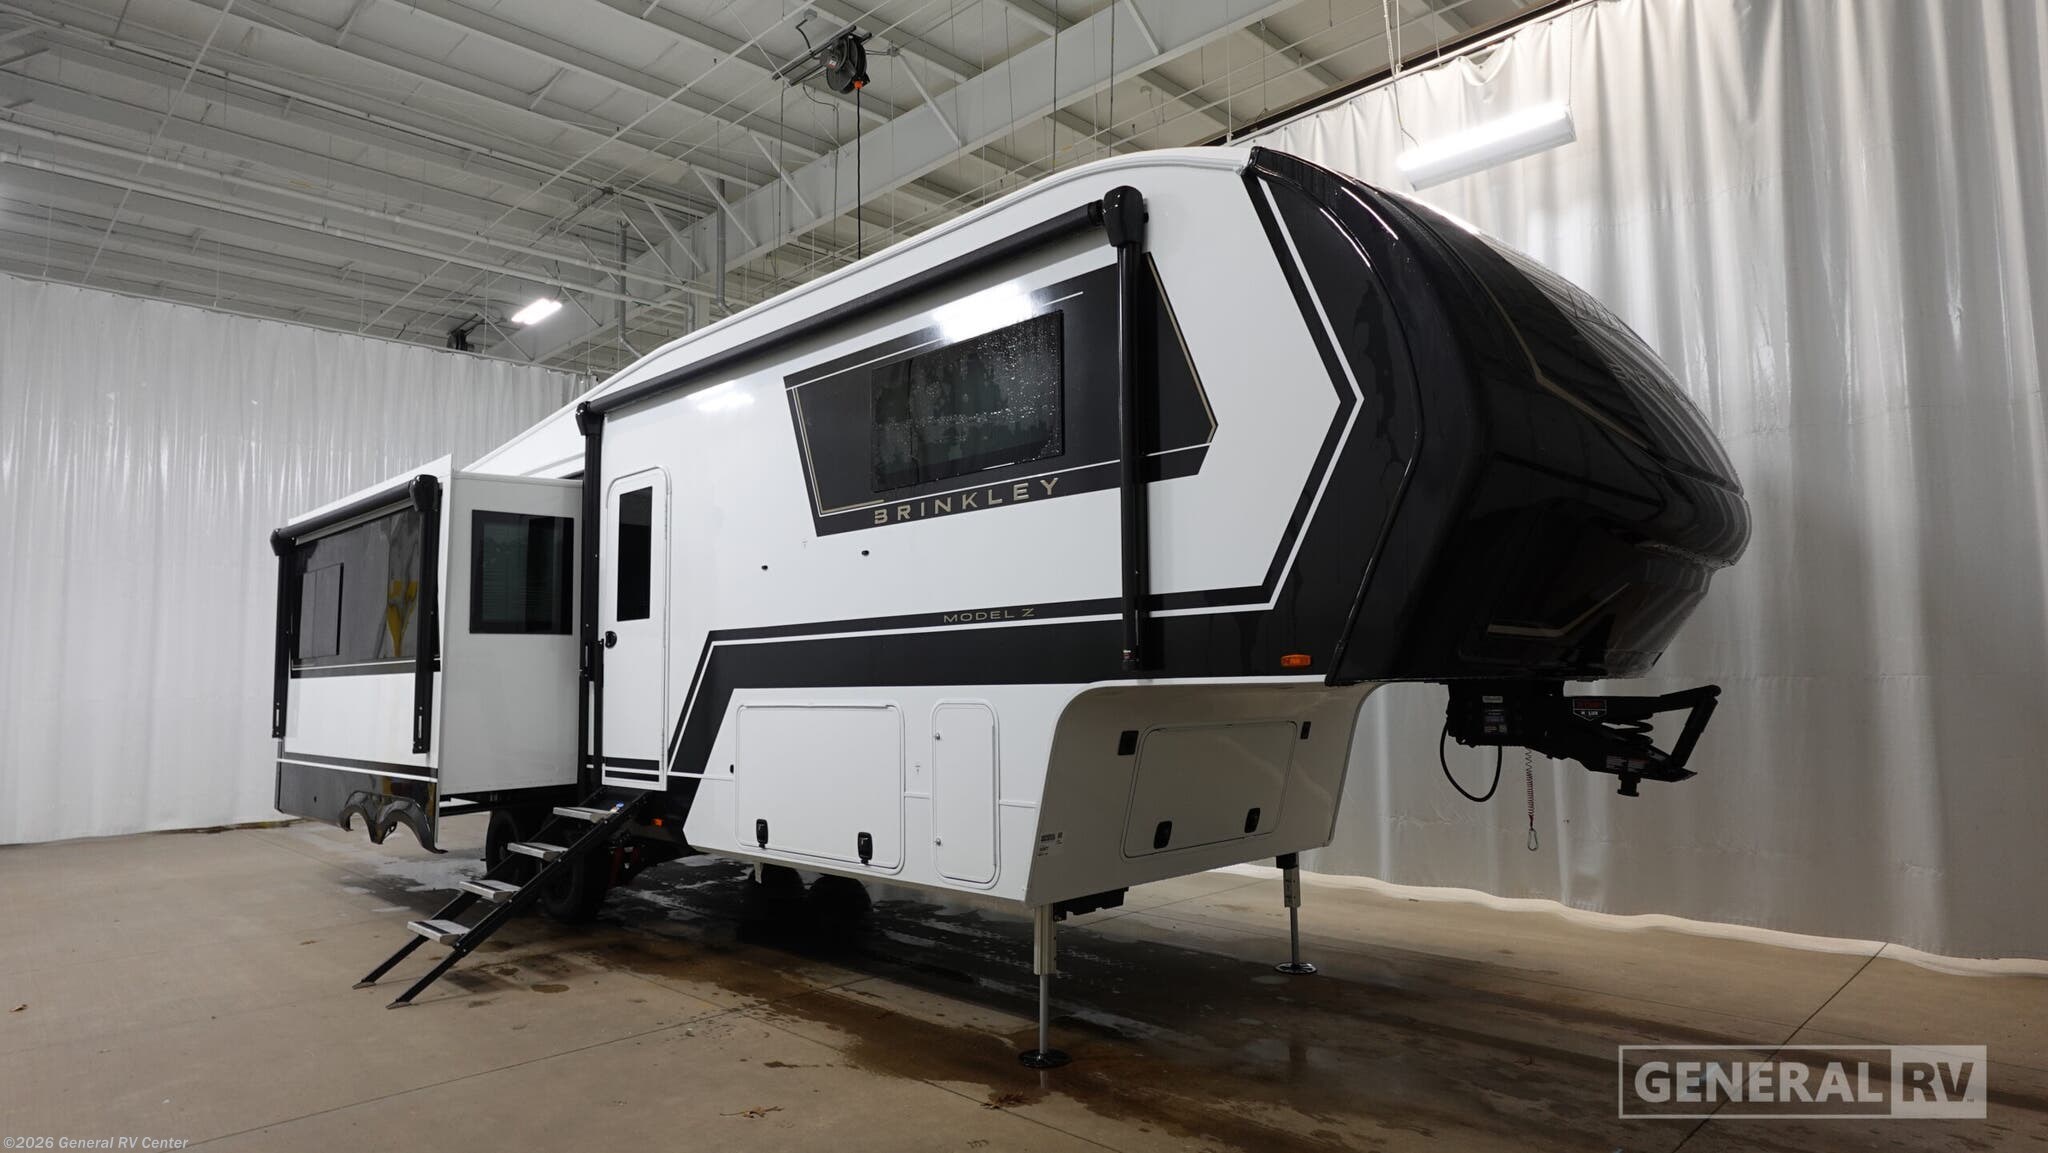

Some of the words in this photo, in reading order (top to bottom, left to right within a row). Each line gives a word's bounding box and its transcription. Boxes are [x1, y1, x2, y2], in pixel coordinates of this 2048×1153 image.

[874, 477, 1060, 525] BRINKLEY
[943, 610, 1014, 624] MODEL
[1022, 608, 1035, 617] Z
